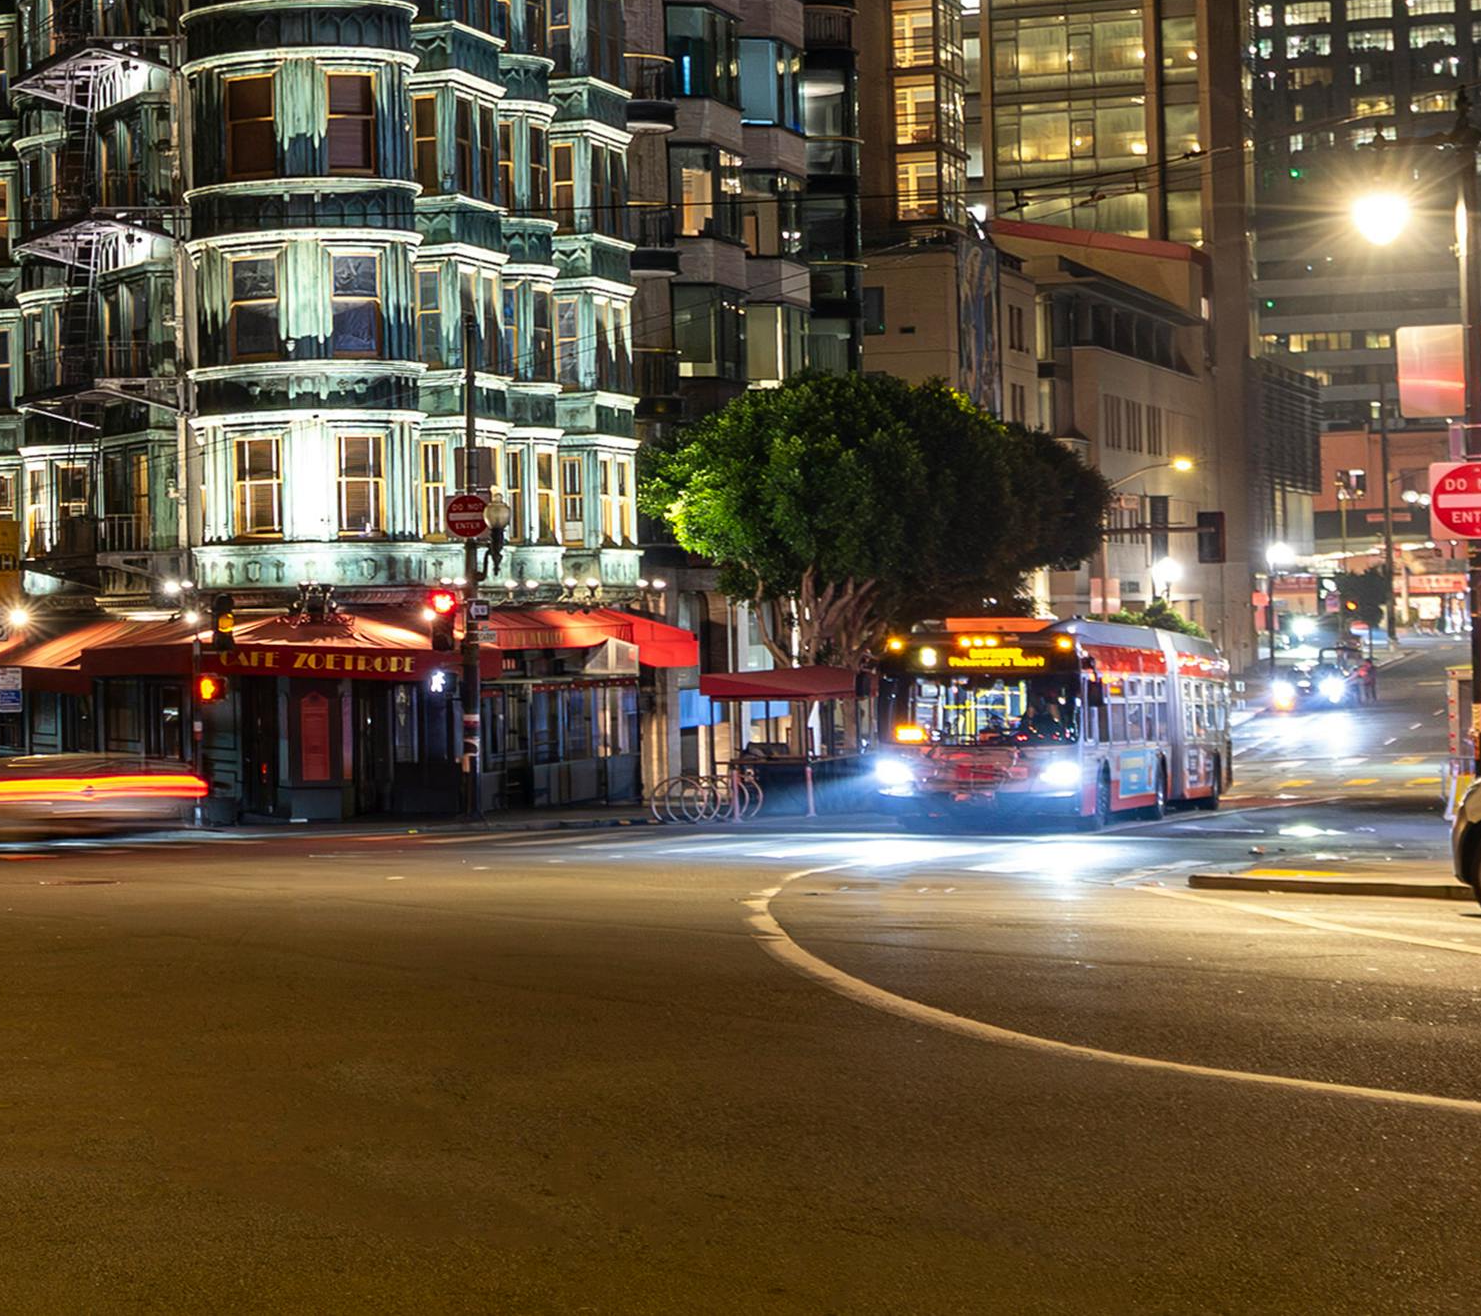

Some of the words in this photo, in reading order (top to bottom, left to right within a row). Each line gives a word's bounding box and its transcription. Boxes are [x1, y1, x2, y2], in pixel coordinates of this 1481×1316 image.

[1444, 478, 1468, 491] DO
[451, 503, 464, 512] DO
[219, 651, 280, 667] CAFE
[293, 653, 416, 673] ZOETROPE
